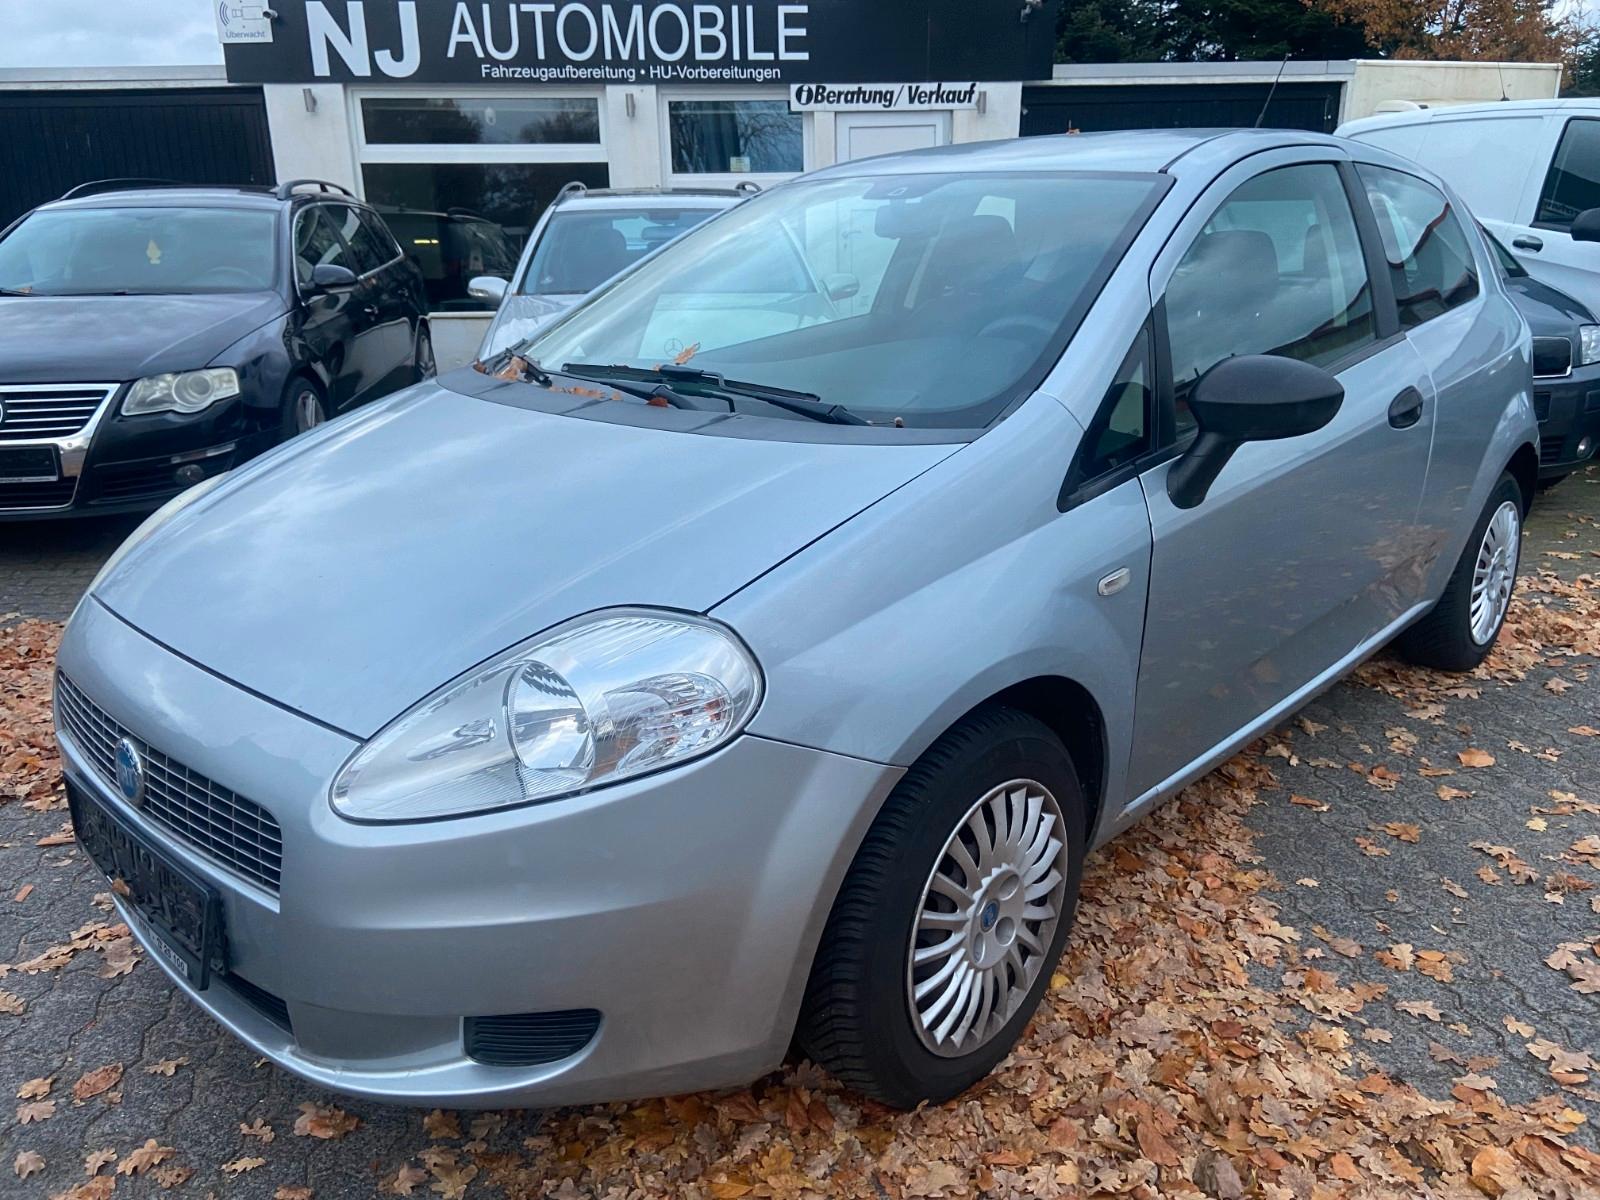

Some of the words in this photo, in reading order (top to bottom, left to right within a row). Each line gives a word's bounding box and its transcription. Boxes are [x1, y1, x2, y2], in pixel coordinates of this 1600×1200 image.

[225, 30, 266, 39] Überwacht
[305, 1, 421, 78] NJ
[447, 2, 810, 62] AUTOMOBILE
[481, 64, 637, 82] Fahrzeugaufbereitung
[649, 65, 781, 82] HU-Vorbereitungen
[907, 82, 977, 105] Verkauf
